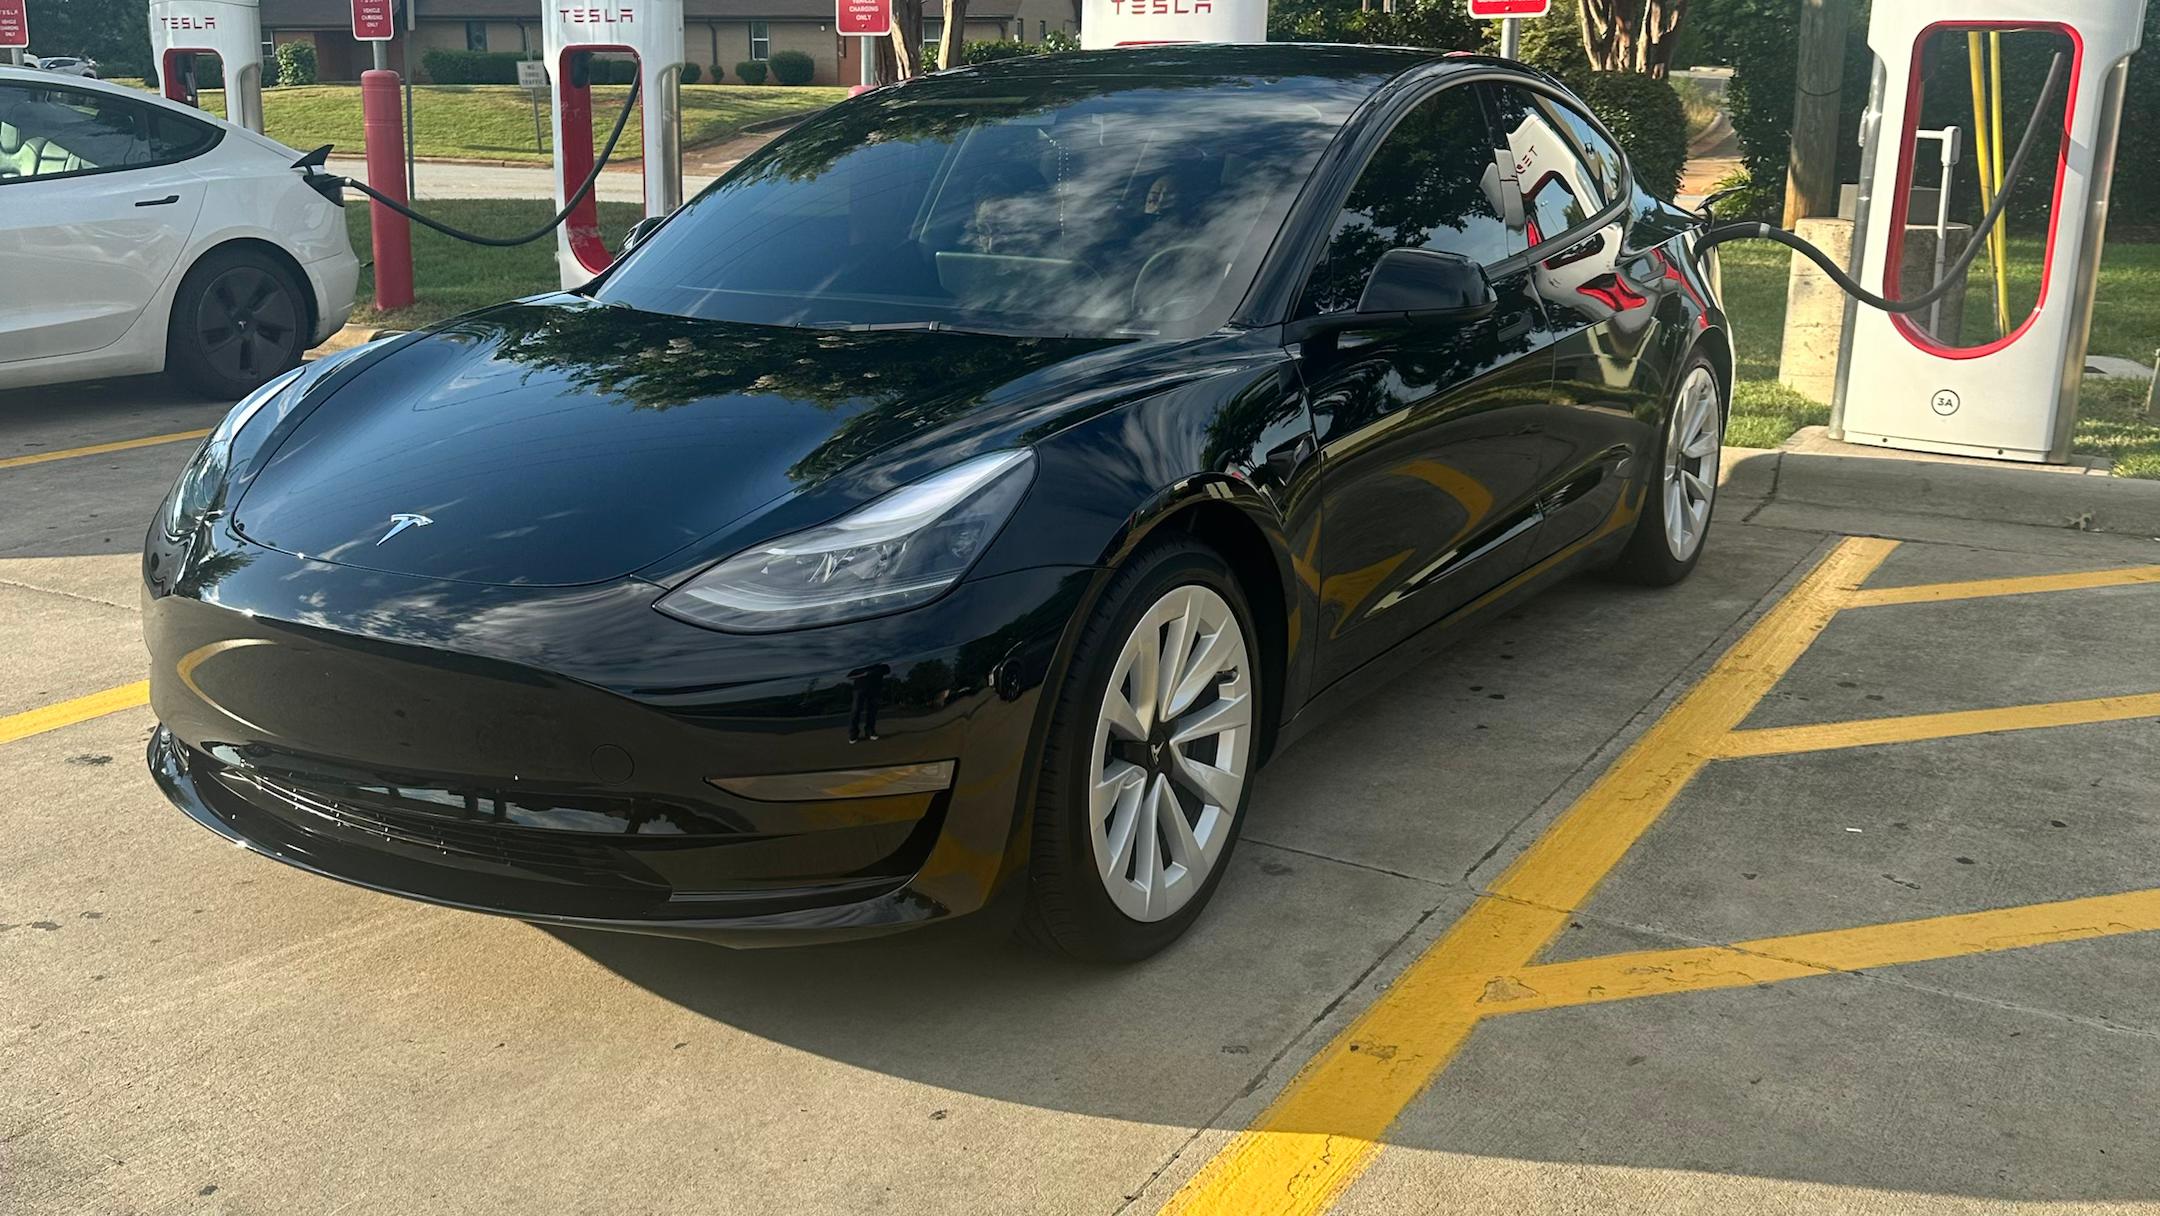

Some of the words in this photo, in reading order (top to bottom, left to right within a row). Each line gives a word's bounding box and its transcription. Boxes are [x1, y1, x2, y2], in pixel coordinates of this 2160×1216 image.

[1111, 0, 1211, 14] TESLA
[559, 9, 633, 23] TESLA
[161, 17, 216, 29] TESLA
[1937, 397, 1953, 407] 3A
